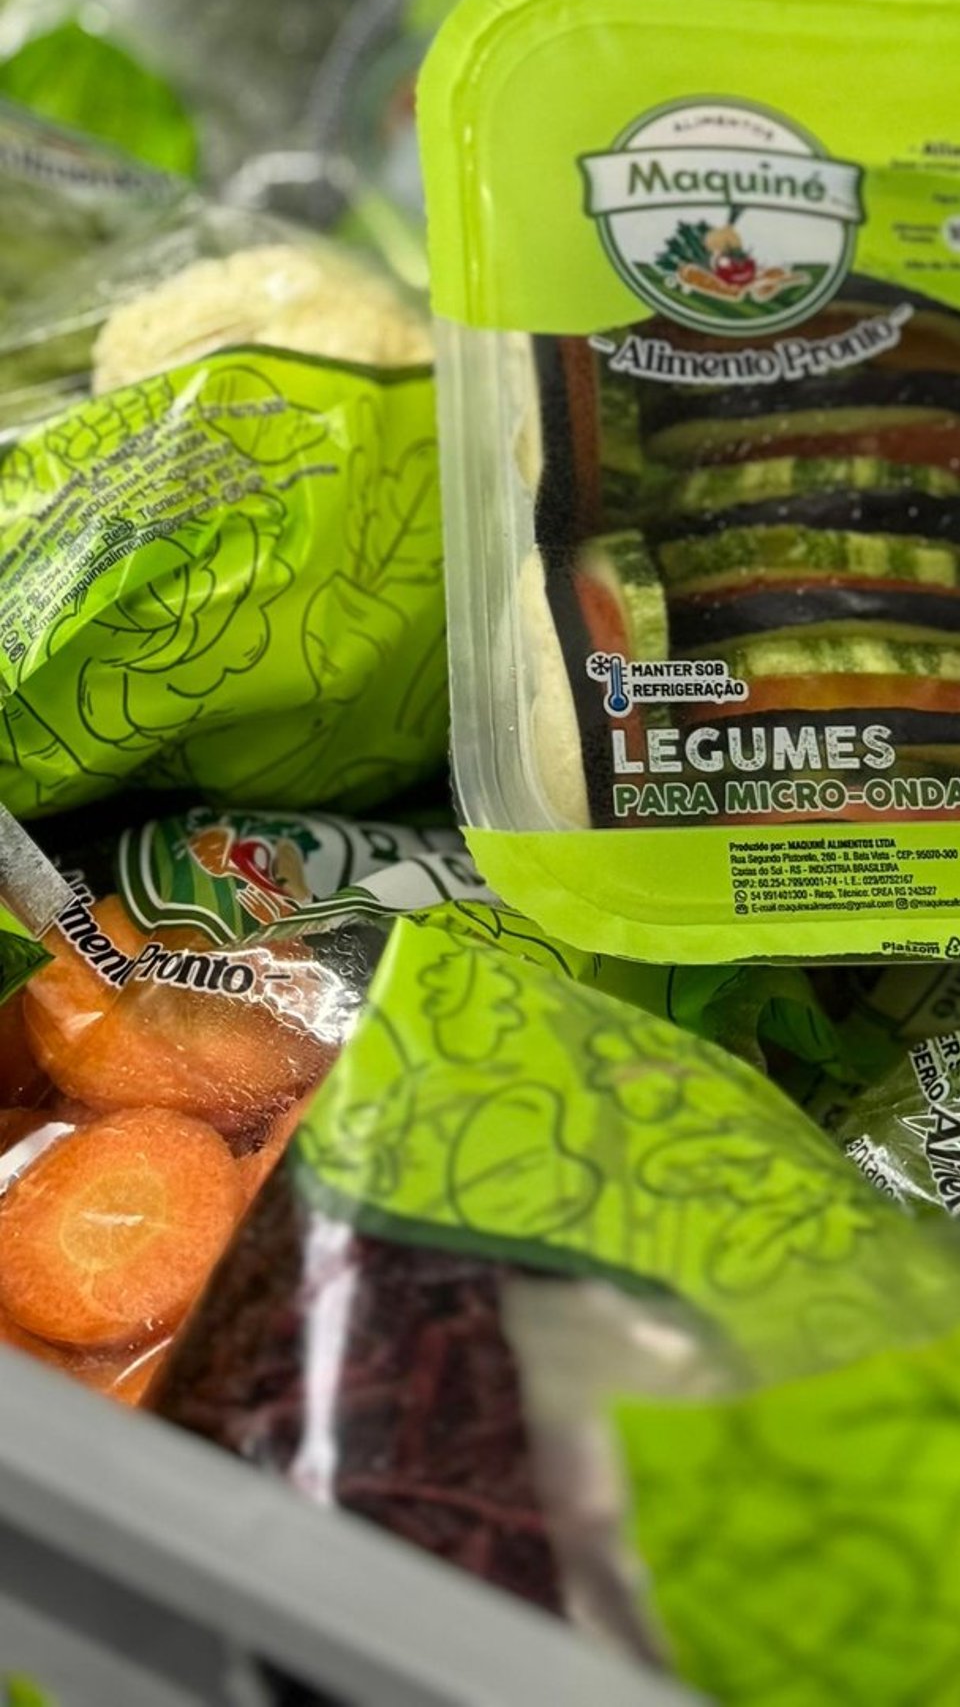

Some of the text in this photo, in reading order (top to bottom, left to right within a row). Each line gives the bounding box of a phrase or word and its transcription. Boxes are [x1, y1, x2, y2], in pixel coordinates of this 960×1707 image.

[627, 159, 828, 205] Maquiné
[612, 320, 895, 381] Alimento Pronto
[630, 663, 725, 678] MANTER SOB
[632, 679, 745, 698] REFRIGERAÇÃO
[611, 725, 897, 775] LEGUMES
[613, 782, 719, 817] PARA
[875, 839, 896, 848] LTDA
[790, 865, 802, 874] RS
[137, 943, 255, 994] Pronto
